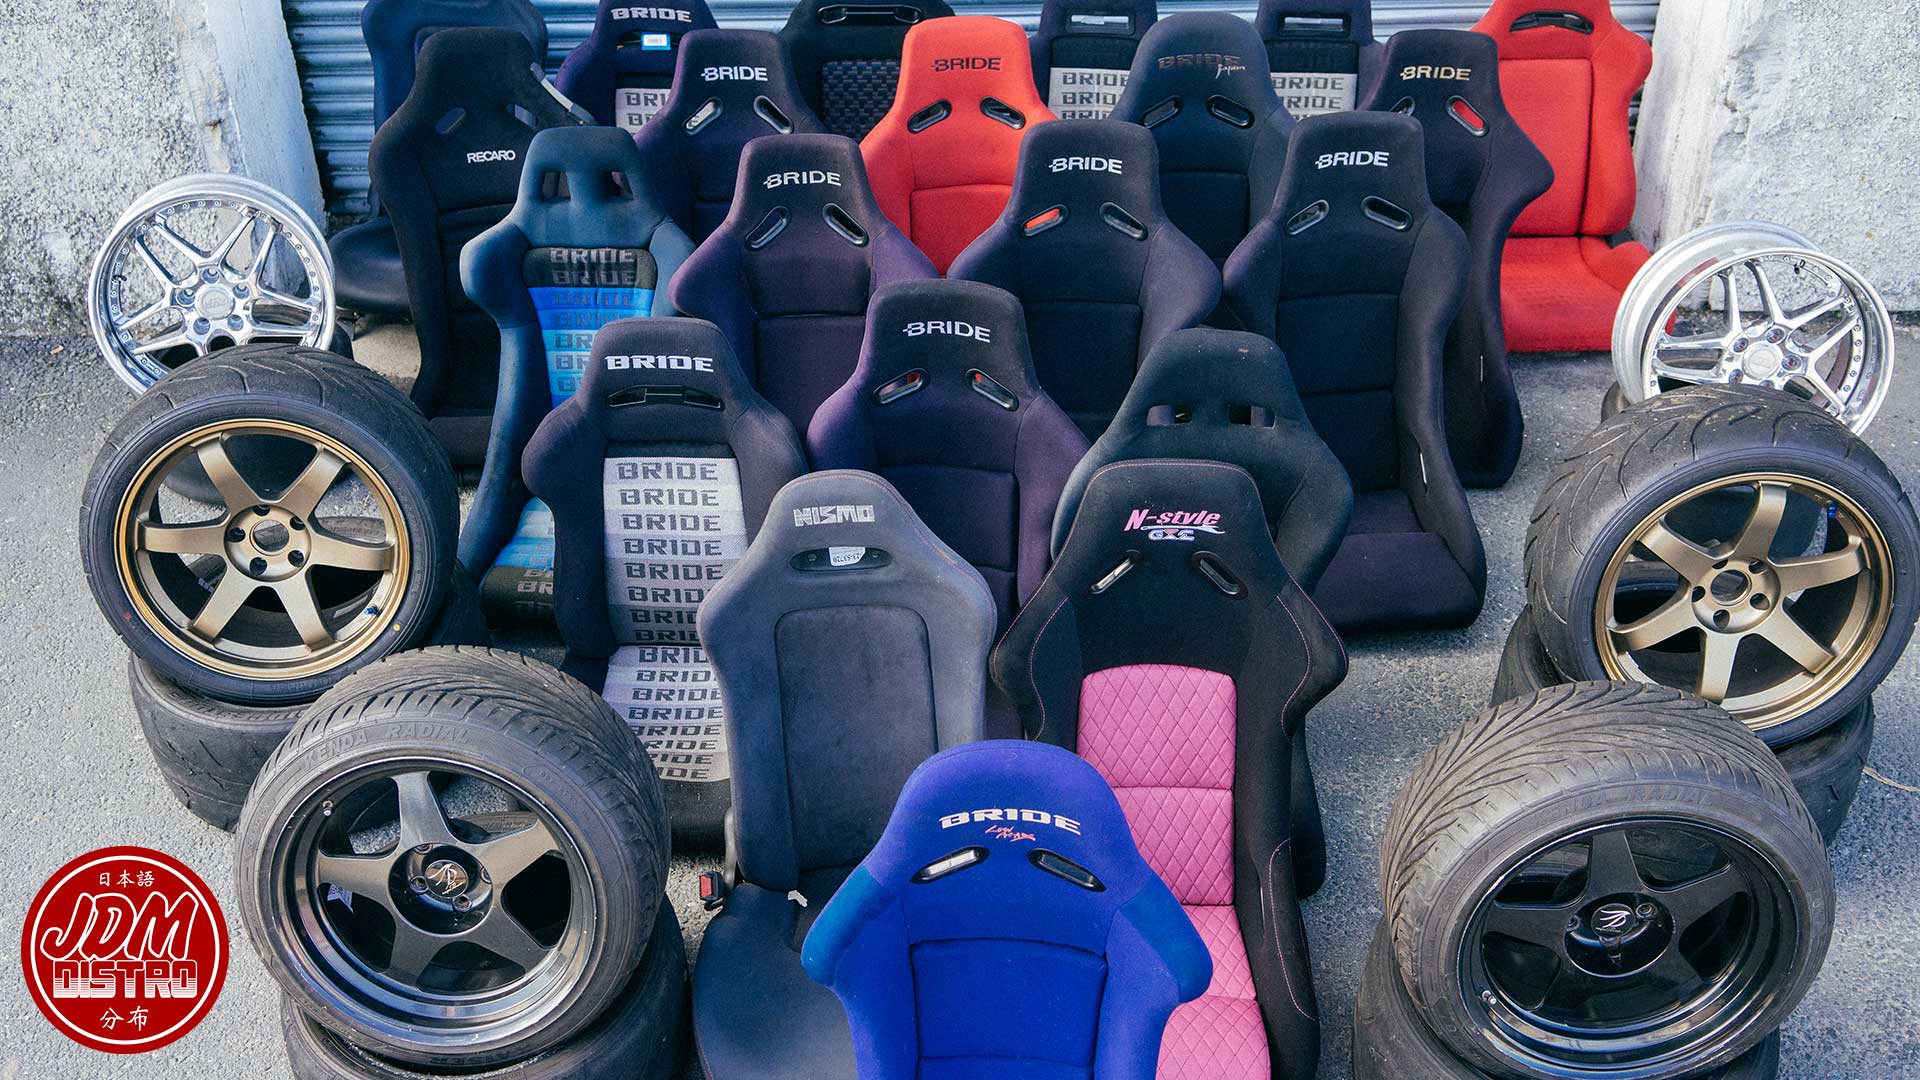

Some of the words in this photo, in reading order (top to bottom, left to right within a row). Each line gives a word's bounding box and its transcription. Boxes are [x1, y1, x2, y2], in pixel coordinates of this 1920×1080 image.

[611, 7, 692, 23] BRIDE
[931, 57, 1001, 72] BRIDE
[1158, 54, 1240, 70] BRIDE
[700, 66, 768, 82] BRIDE
[1400, 65, 1471, 81] BRIDE
[1272, 77, 1344, 90] BRIDE
[625, 92, 666, 107] BRI
[1061, 92, 1117, 105] BRID
[1281, 96, 1342, 109] RIDE
[467, 150, 516, 163] RECARO
[1315, 151, 1390, 169] BRIDE
[1049, 157, 1123, 174] BRIDE
[763, 170, 842, 189] BRIDE
[550, 248, 634, 263] BRIDE
[552, 270, 636, 285] BRIDE
[903, 321, 991, 343] BRIDE
[604, 355, 714, 373] BRIDE
[616, 462, 718, 481] BRIDE
[618, 488, 719, 507] BRIDE
[621, 514, 721, 532] BRIDE
[793, 505, 875, 527] NISMO
[1124, 508, 1221, 531] N-style
[622, 538, 722, 556] BRIDE
[624, 562, 723, 580] BRIDE
[626, 586, 711, 603] BRID
[638, 647, 710, 664] BRID
[636, 670, 717, 682] BRID
[628, 706, 724, 720] BRIDE
[303, 728, 369, 771] KENDA
[386, 721, 469, 744] RADIAL
[644, 740, 718, 750] RIDE
[649, 754, 714, 764] IDE
[657, 767, 710, 779] IDE
[938, 808, 1081, 836] BRIDE
